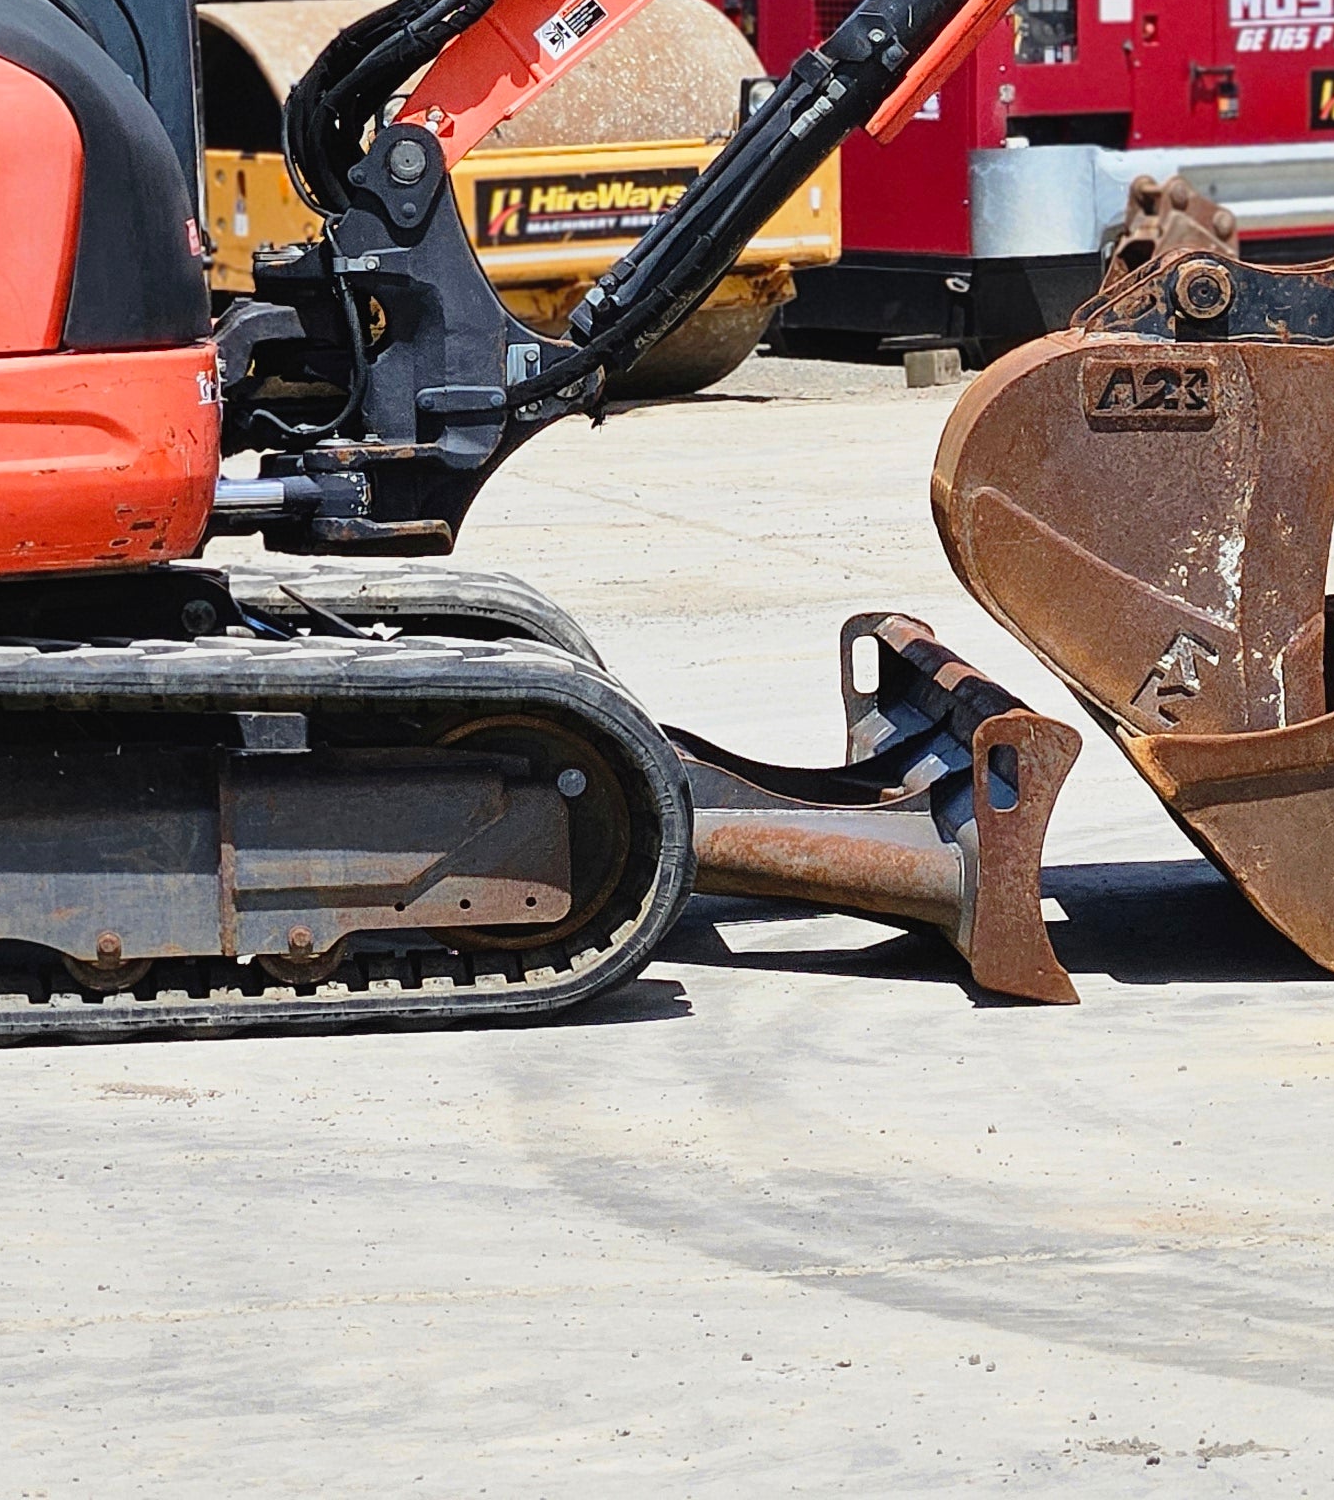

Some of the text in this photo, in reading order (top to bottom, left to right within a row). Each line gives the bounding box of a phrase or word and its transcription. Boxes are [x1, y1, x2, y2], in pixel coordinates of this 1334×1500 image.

[1236, 27, 1267, 52] GE
[1269, 26, 1312, 51] 165
[1313, 25, 1334, 49] P
[528, 181, 688, 214] HireWays
[1094, 366, 1211, 411] A23
